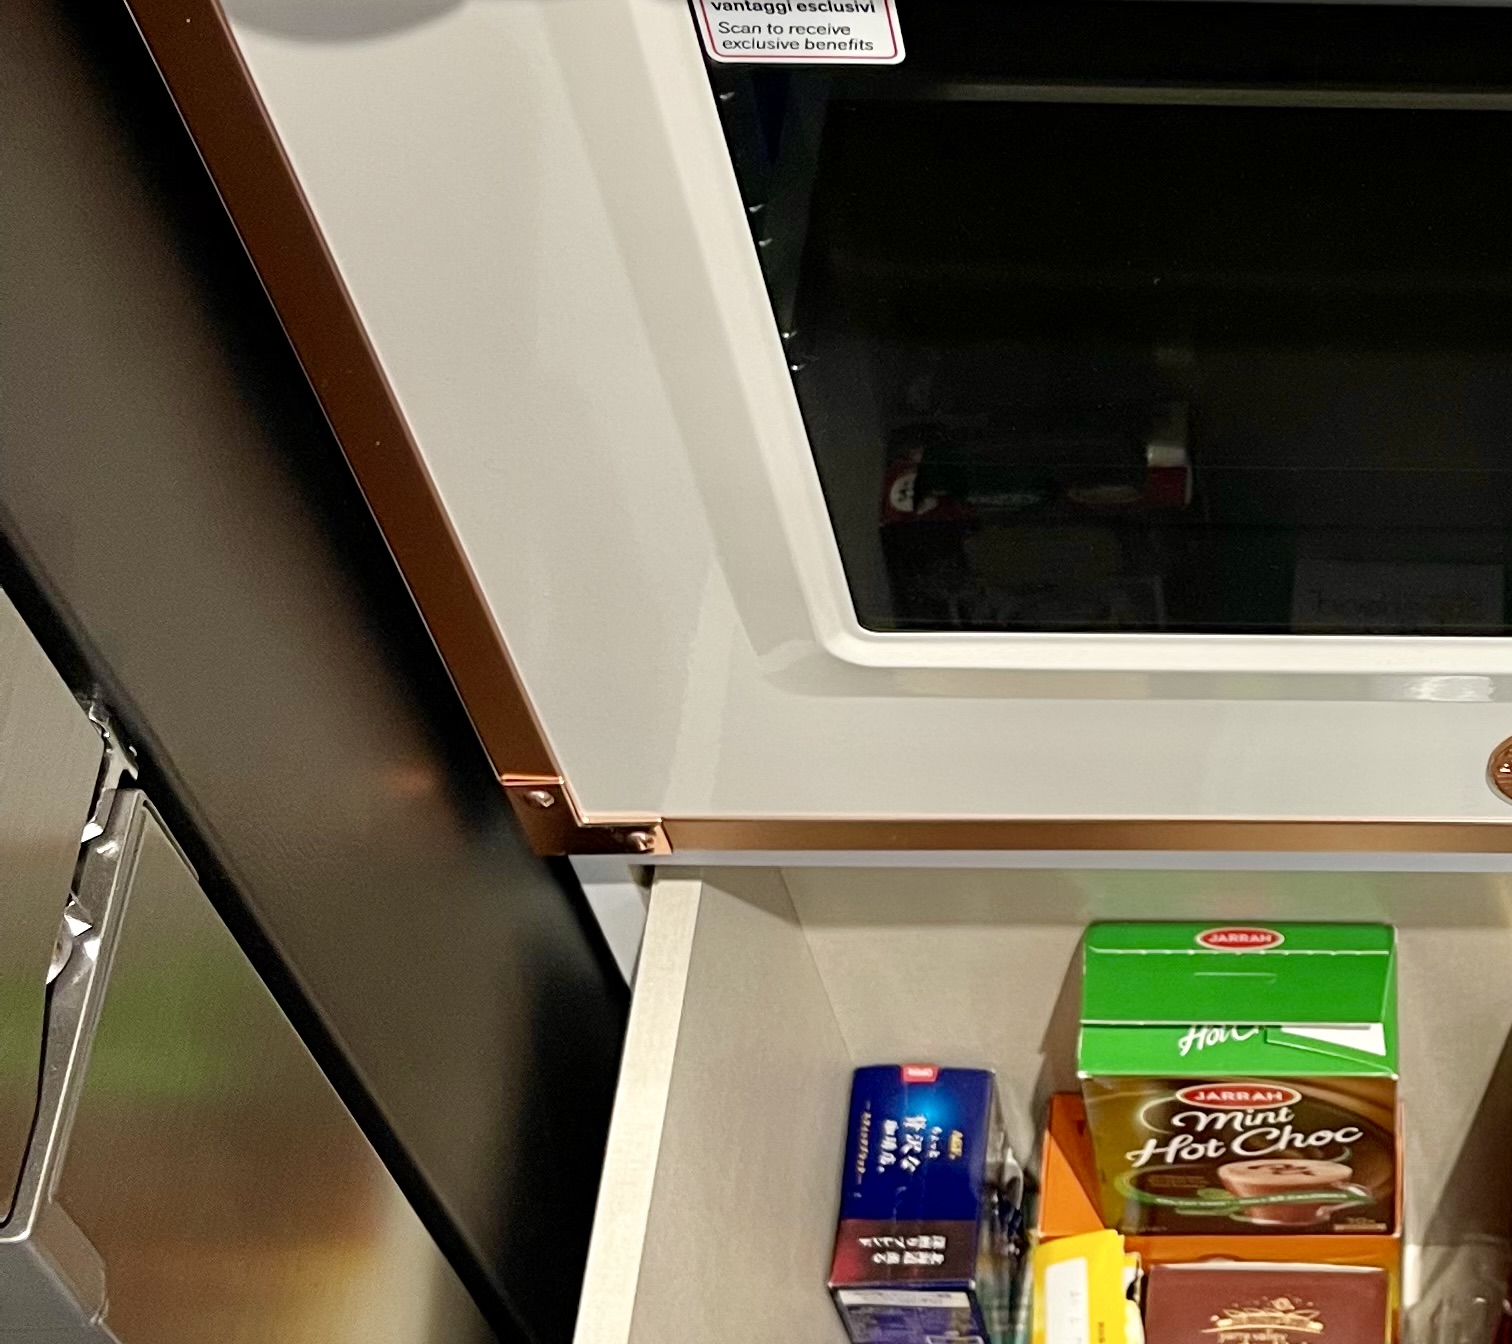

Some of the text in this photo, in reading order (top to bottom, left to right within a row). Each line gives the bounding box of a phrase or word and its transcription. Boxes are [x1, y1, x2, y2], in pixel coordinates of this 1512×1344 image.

[711, 0, 876, 15] vantaggi esclusivi
[718, 21, 851, 36] Scan to receive
[722, 37, 874, 51] exclusive benefits
[1207, 933, 1273, 944] JARRAH
[1193, 1090, 1283, 1102] JARRAH
[1171, 1107, 1295, 1133] Mint
[1125, 1127, 1364, 1168] Hot Choc
